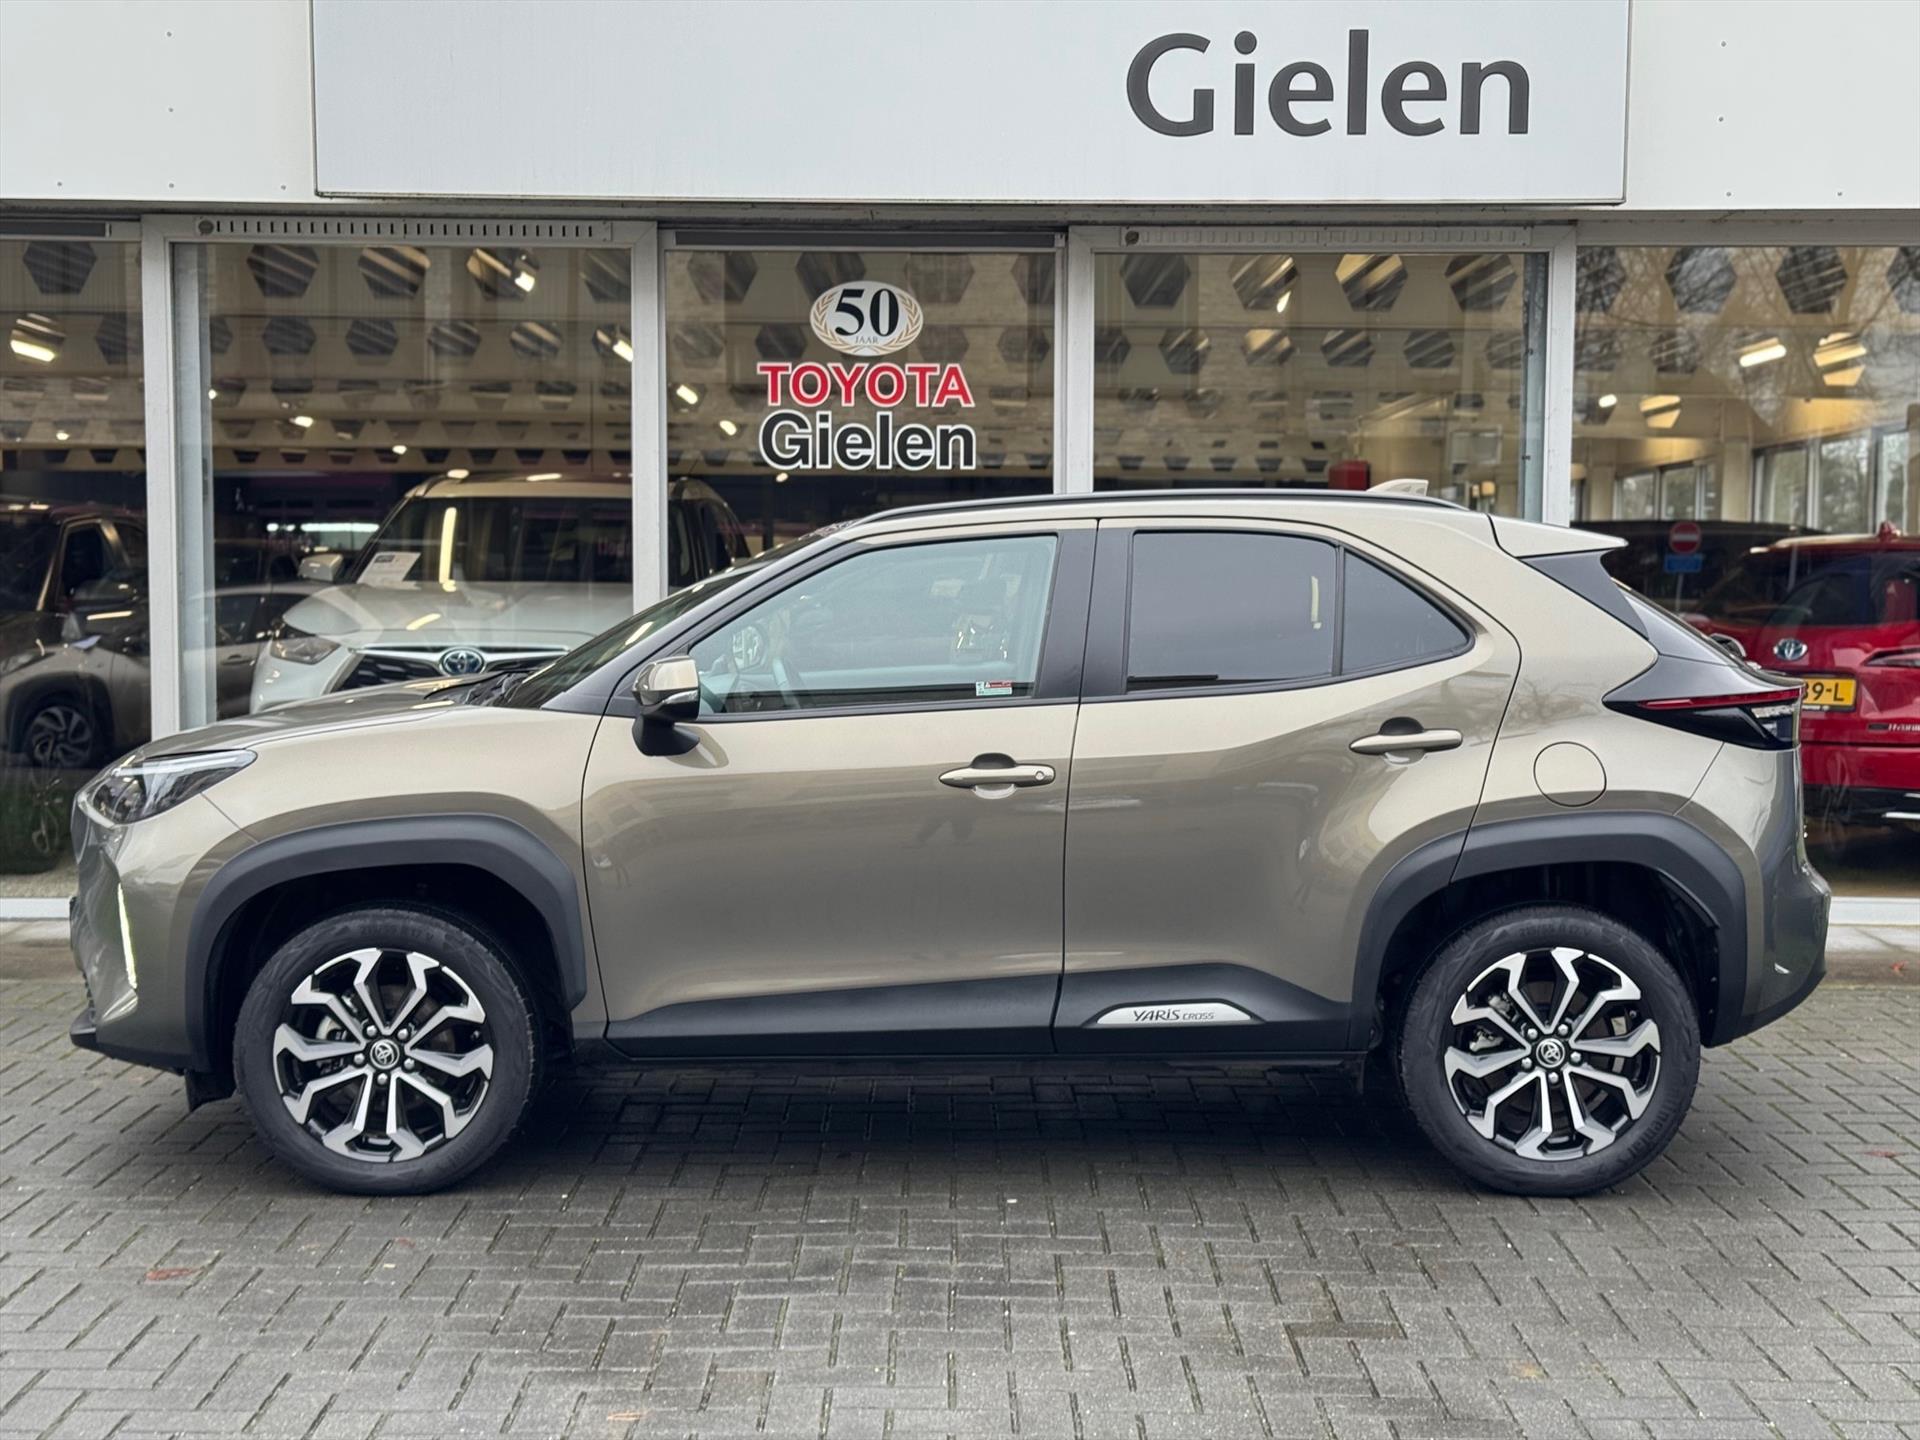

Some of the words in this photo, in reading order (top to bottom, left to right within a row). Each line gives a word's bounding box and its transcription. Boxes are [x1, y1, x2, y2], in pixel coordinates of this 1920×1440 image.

[1126, 29, 1530, 137] Gielen
[834, 288, 900, 337] 50
[855, 335, 879, 345] JAAR
[757, 362, 975, 408] TOYOTA
[758, 409, 977, 470] Gielen
[1183, 1011, 1215, 1021] CROSS
